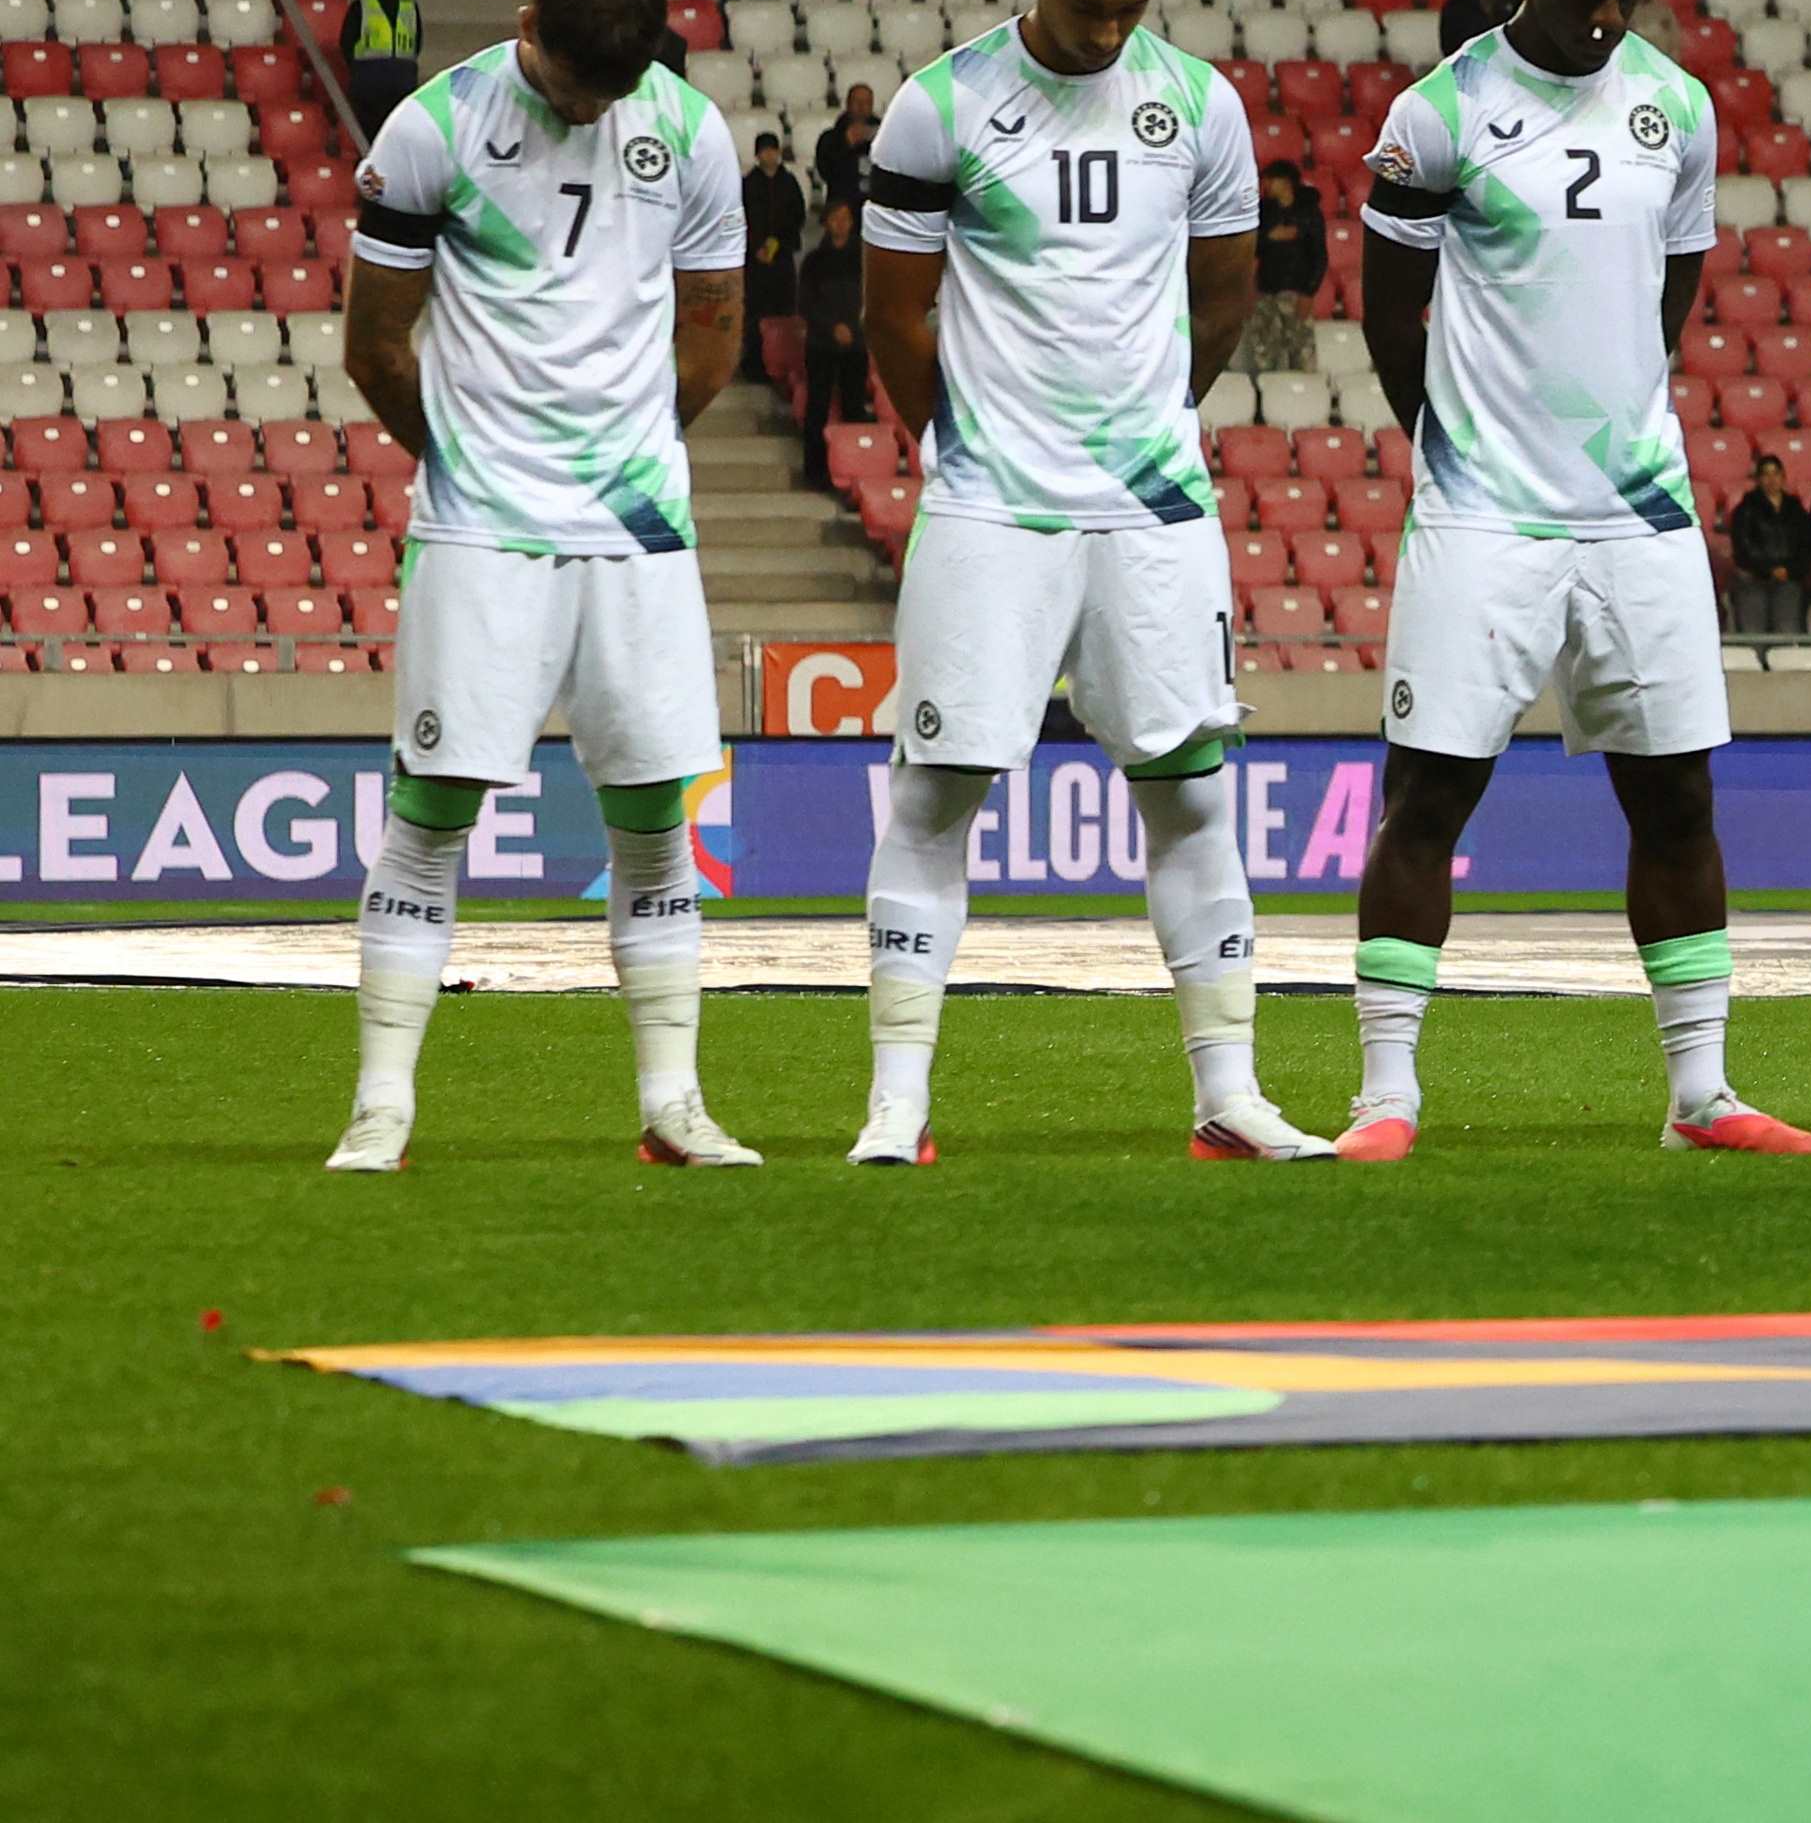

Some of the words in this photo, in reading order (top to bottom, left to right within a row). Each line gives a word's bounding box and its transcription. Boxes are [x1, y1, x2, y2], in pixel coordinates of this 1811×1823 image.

[558, 183, 592, 258] 7
[1052, 149, 1118, 224] 10
[1564, 149, 1603, 220] 2
[0, 770, 544, 880] EAGE
[367, 892, 447, 924] ÉIRE
